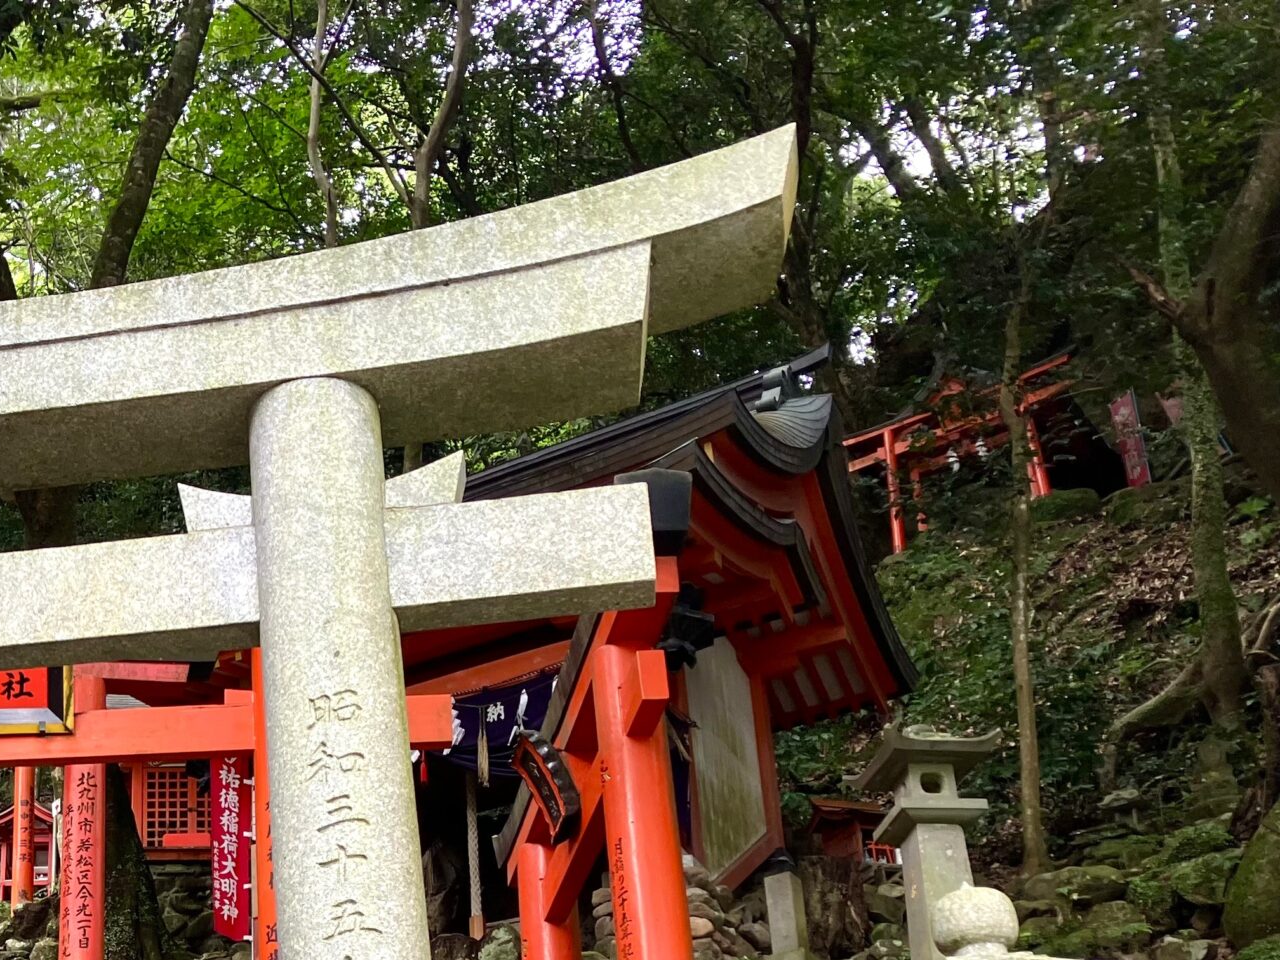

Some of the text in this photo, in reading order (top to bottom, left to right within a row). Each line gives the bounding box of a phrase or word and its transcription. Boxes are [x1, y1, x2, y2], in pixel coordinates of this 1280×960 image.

[0, 672, 33, 700] 社
[487, 702, 505, 722] 納
[76, 772, 97, 948] 北九州市若松区今光一丁目
[219, 765, 240, 924] 祐徳稲荷大明神
